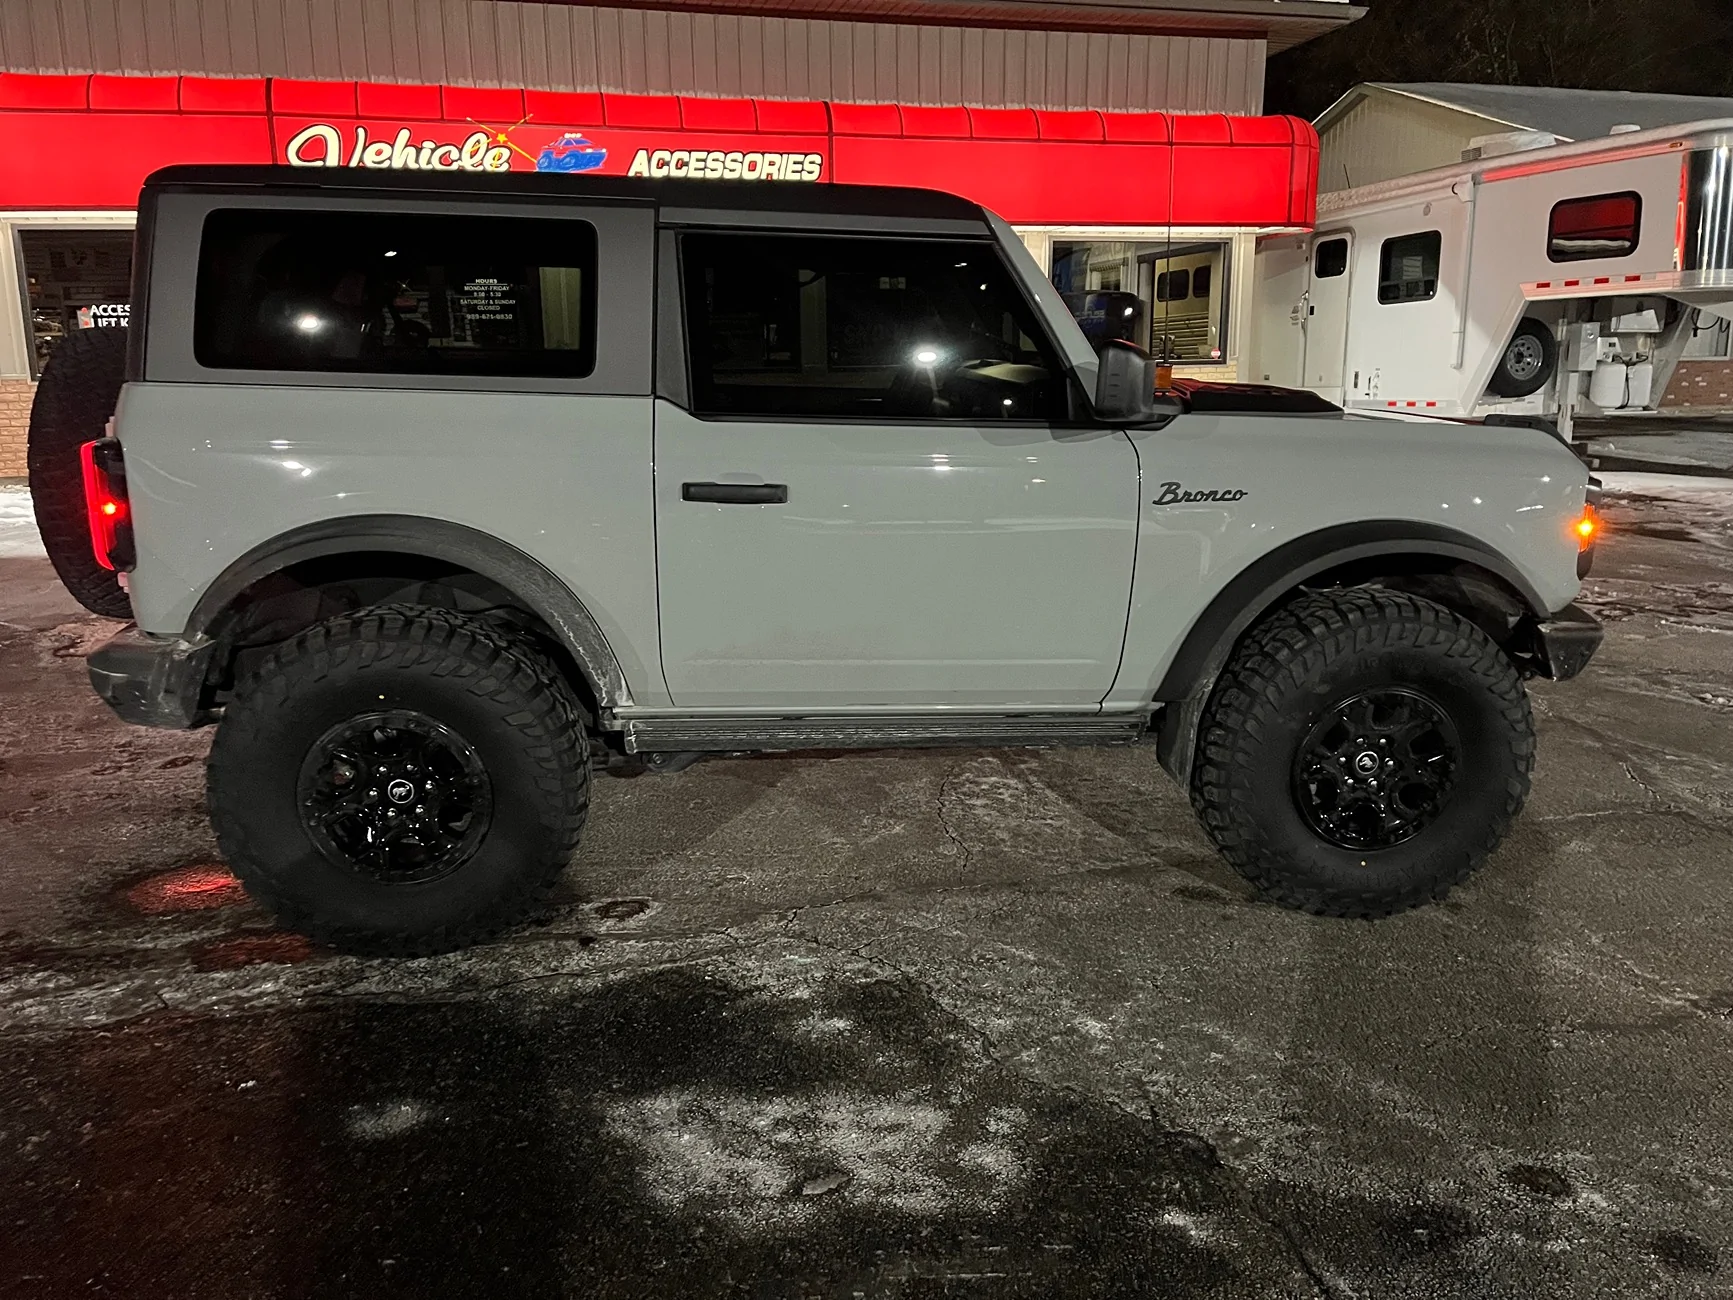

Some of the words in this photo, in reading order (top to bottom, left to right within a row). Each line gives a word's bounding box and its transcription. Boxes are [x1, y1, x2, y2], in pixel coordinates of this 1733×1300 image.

[287, 124, 511, 172] Vehicle
[627, 149, 822, 182] ACCESSORIES
[1152, 481, 1249, 506] Bronco
